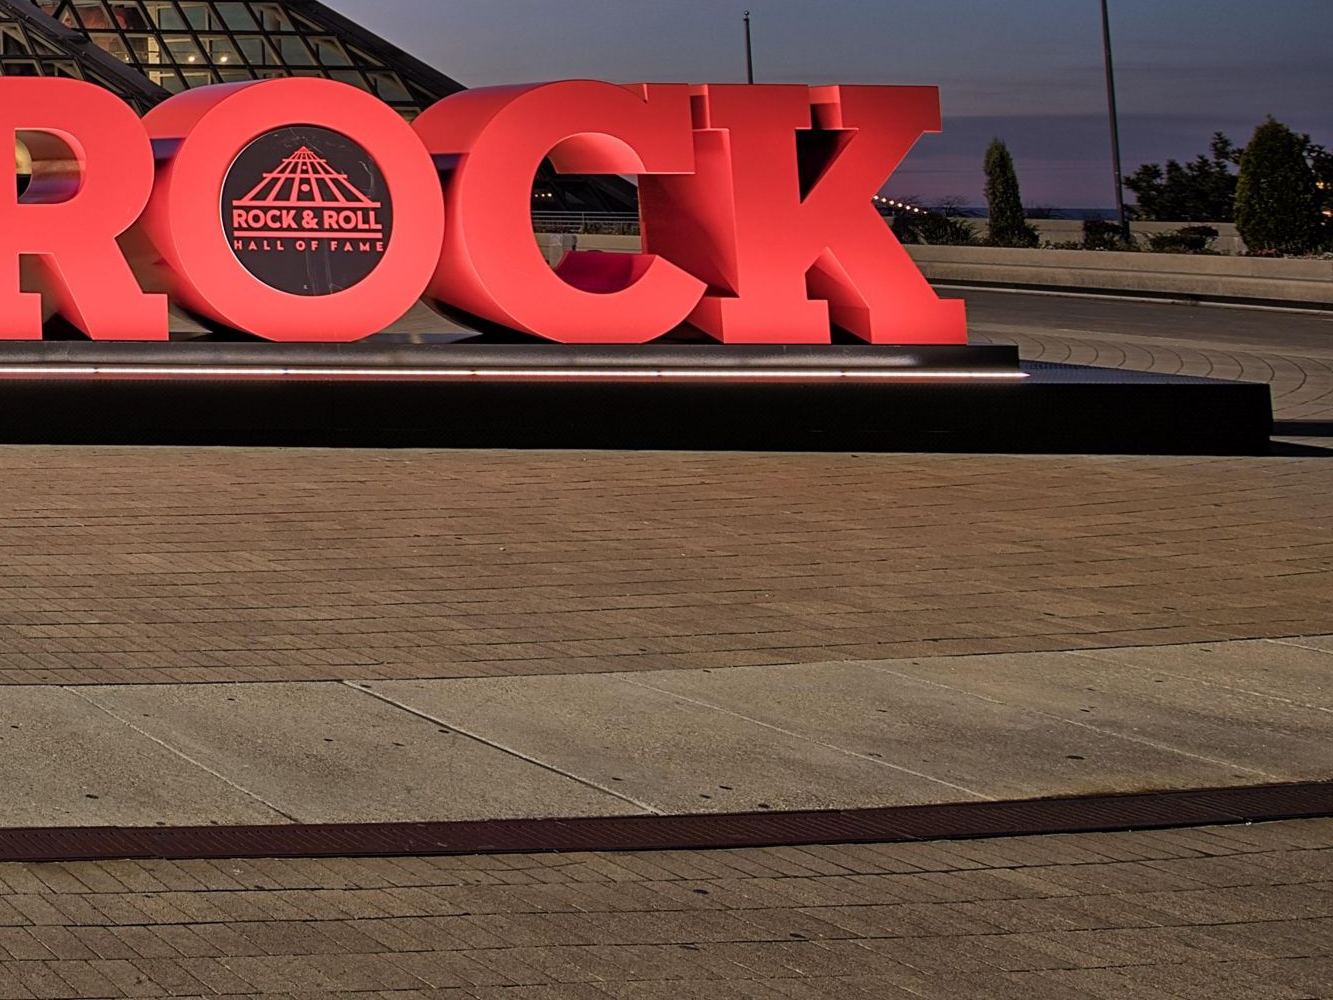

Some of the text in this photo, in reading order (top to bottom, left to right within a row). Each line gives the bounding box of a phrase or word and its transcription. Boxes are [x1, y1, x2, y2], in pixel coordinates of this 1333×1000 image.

[233, 208, 382, 230] ROCK & ROLL
[234, 239, 384, 252] HALL OF FAME
